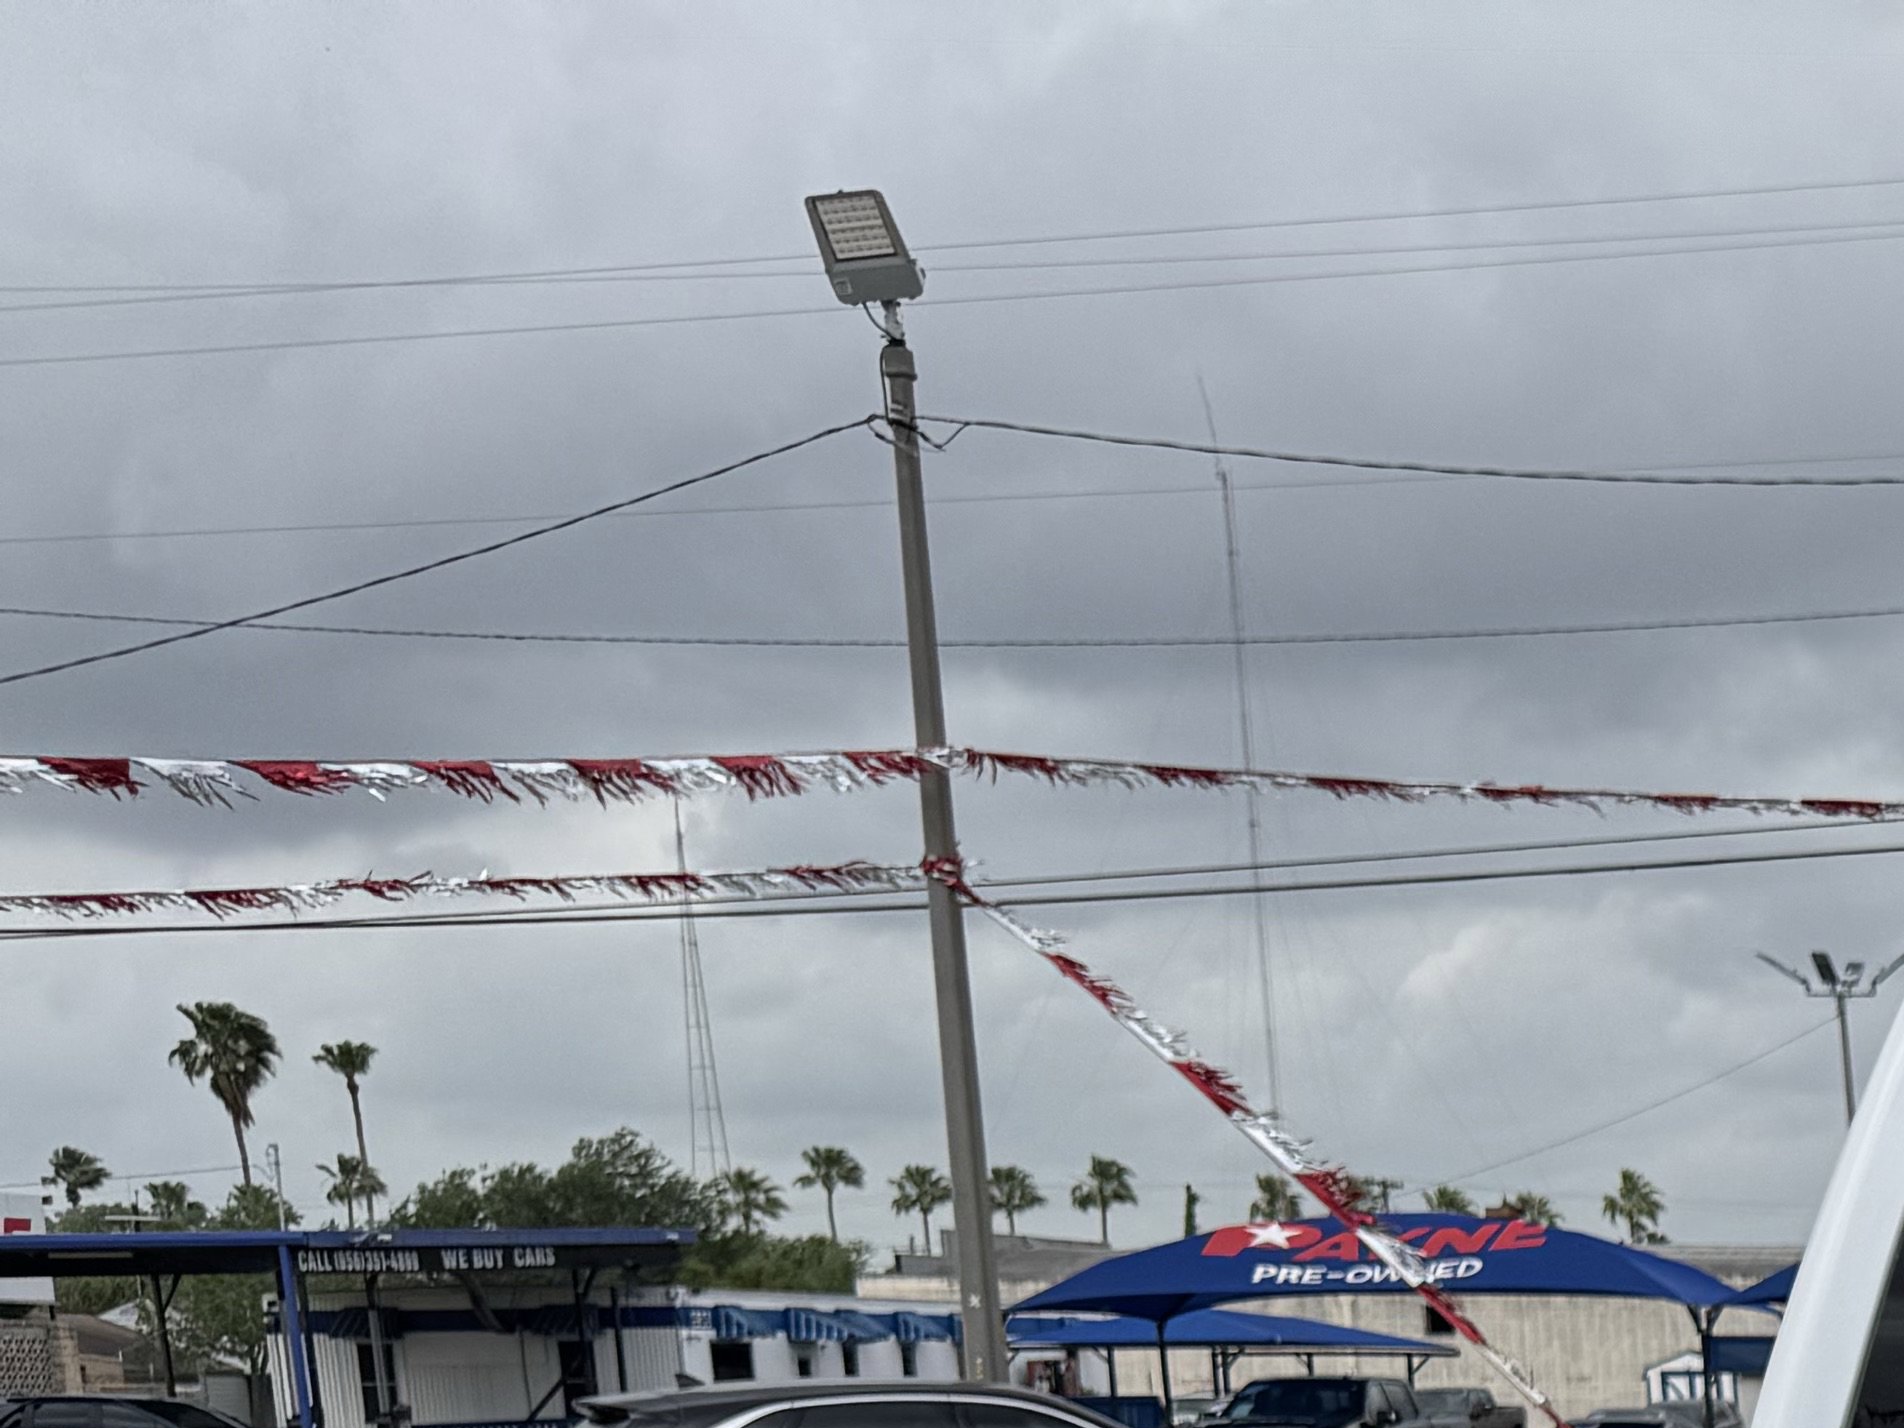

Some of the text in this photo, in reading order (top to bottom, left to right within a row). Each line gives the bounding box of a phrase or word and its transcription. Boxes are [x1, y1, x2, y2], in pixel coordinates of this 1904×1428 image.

[298, 1250, 332, 1272] CALL
[441, 1249, 469, 1270] WE
[473, 1249, 504, 1270] BUY
[513, 1247, 556, 1269] CARS
